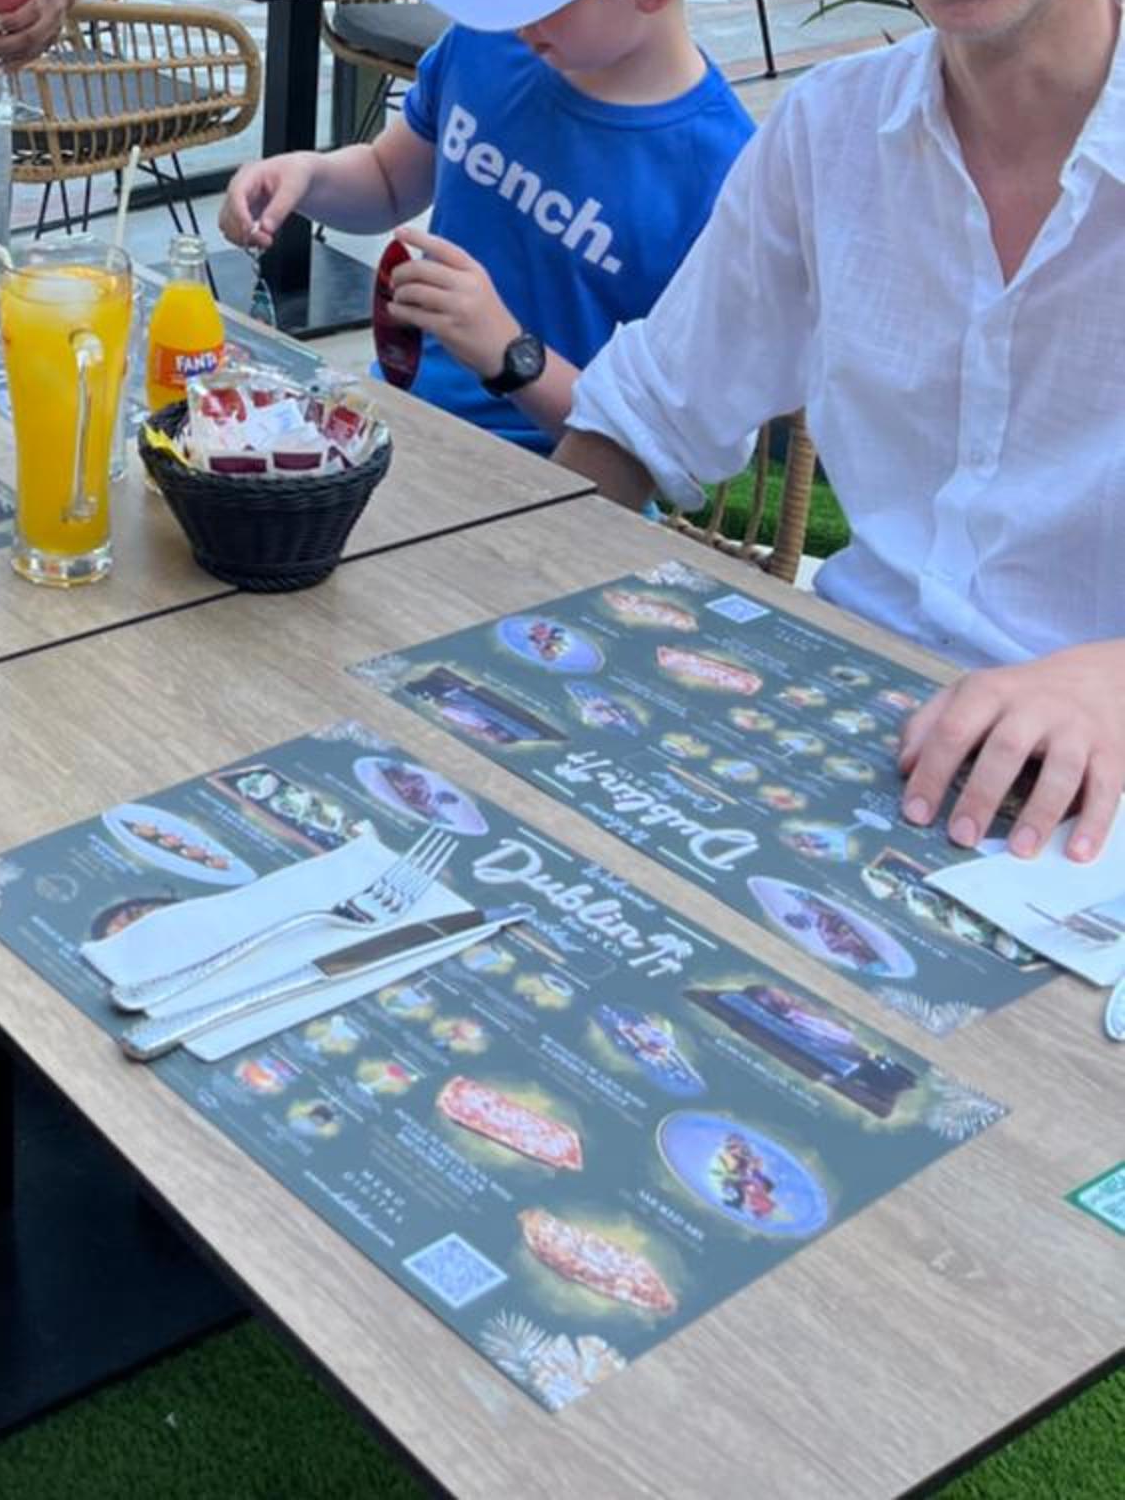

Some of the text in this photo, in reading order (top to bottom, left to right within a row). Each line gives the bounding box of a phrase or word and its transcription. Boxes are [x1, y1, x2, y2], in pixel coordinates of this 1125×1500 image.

[443, 104, 622, 274] Bench.
[597, 772, 759, 871] Dublin
[472, 838, 644, 948] Dublin
